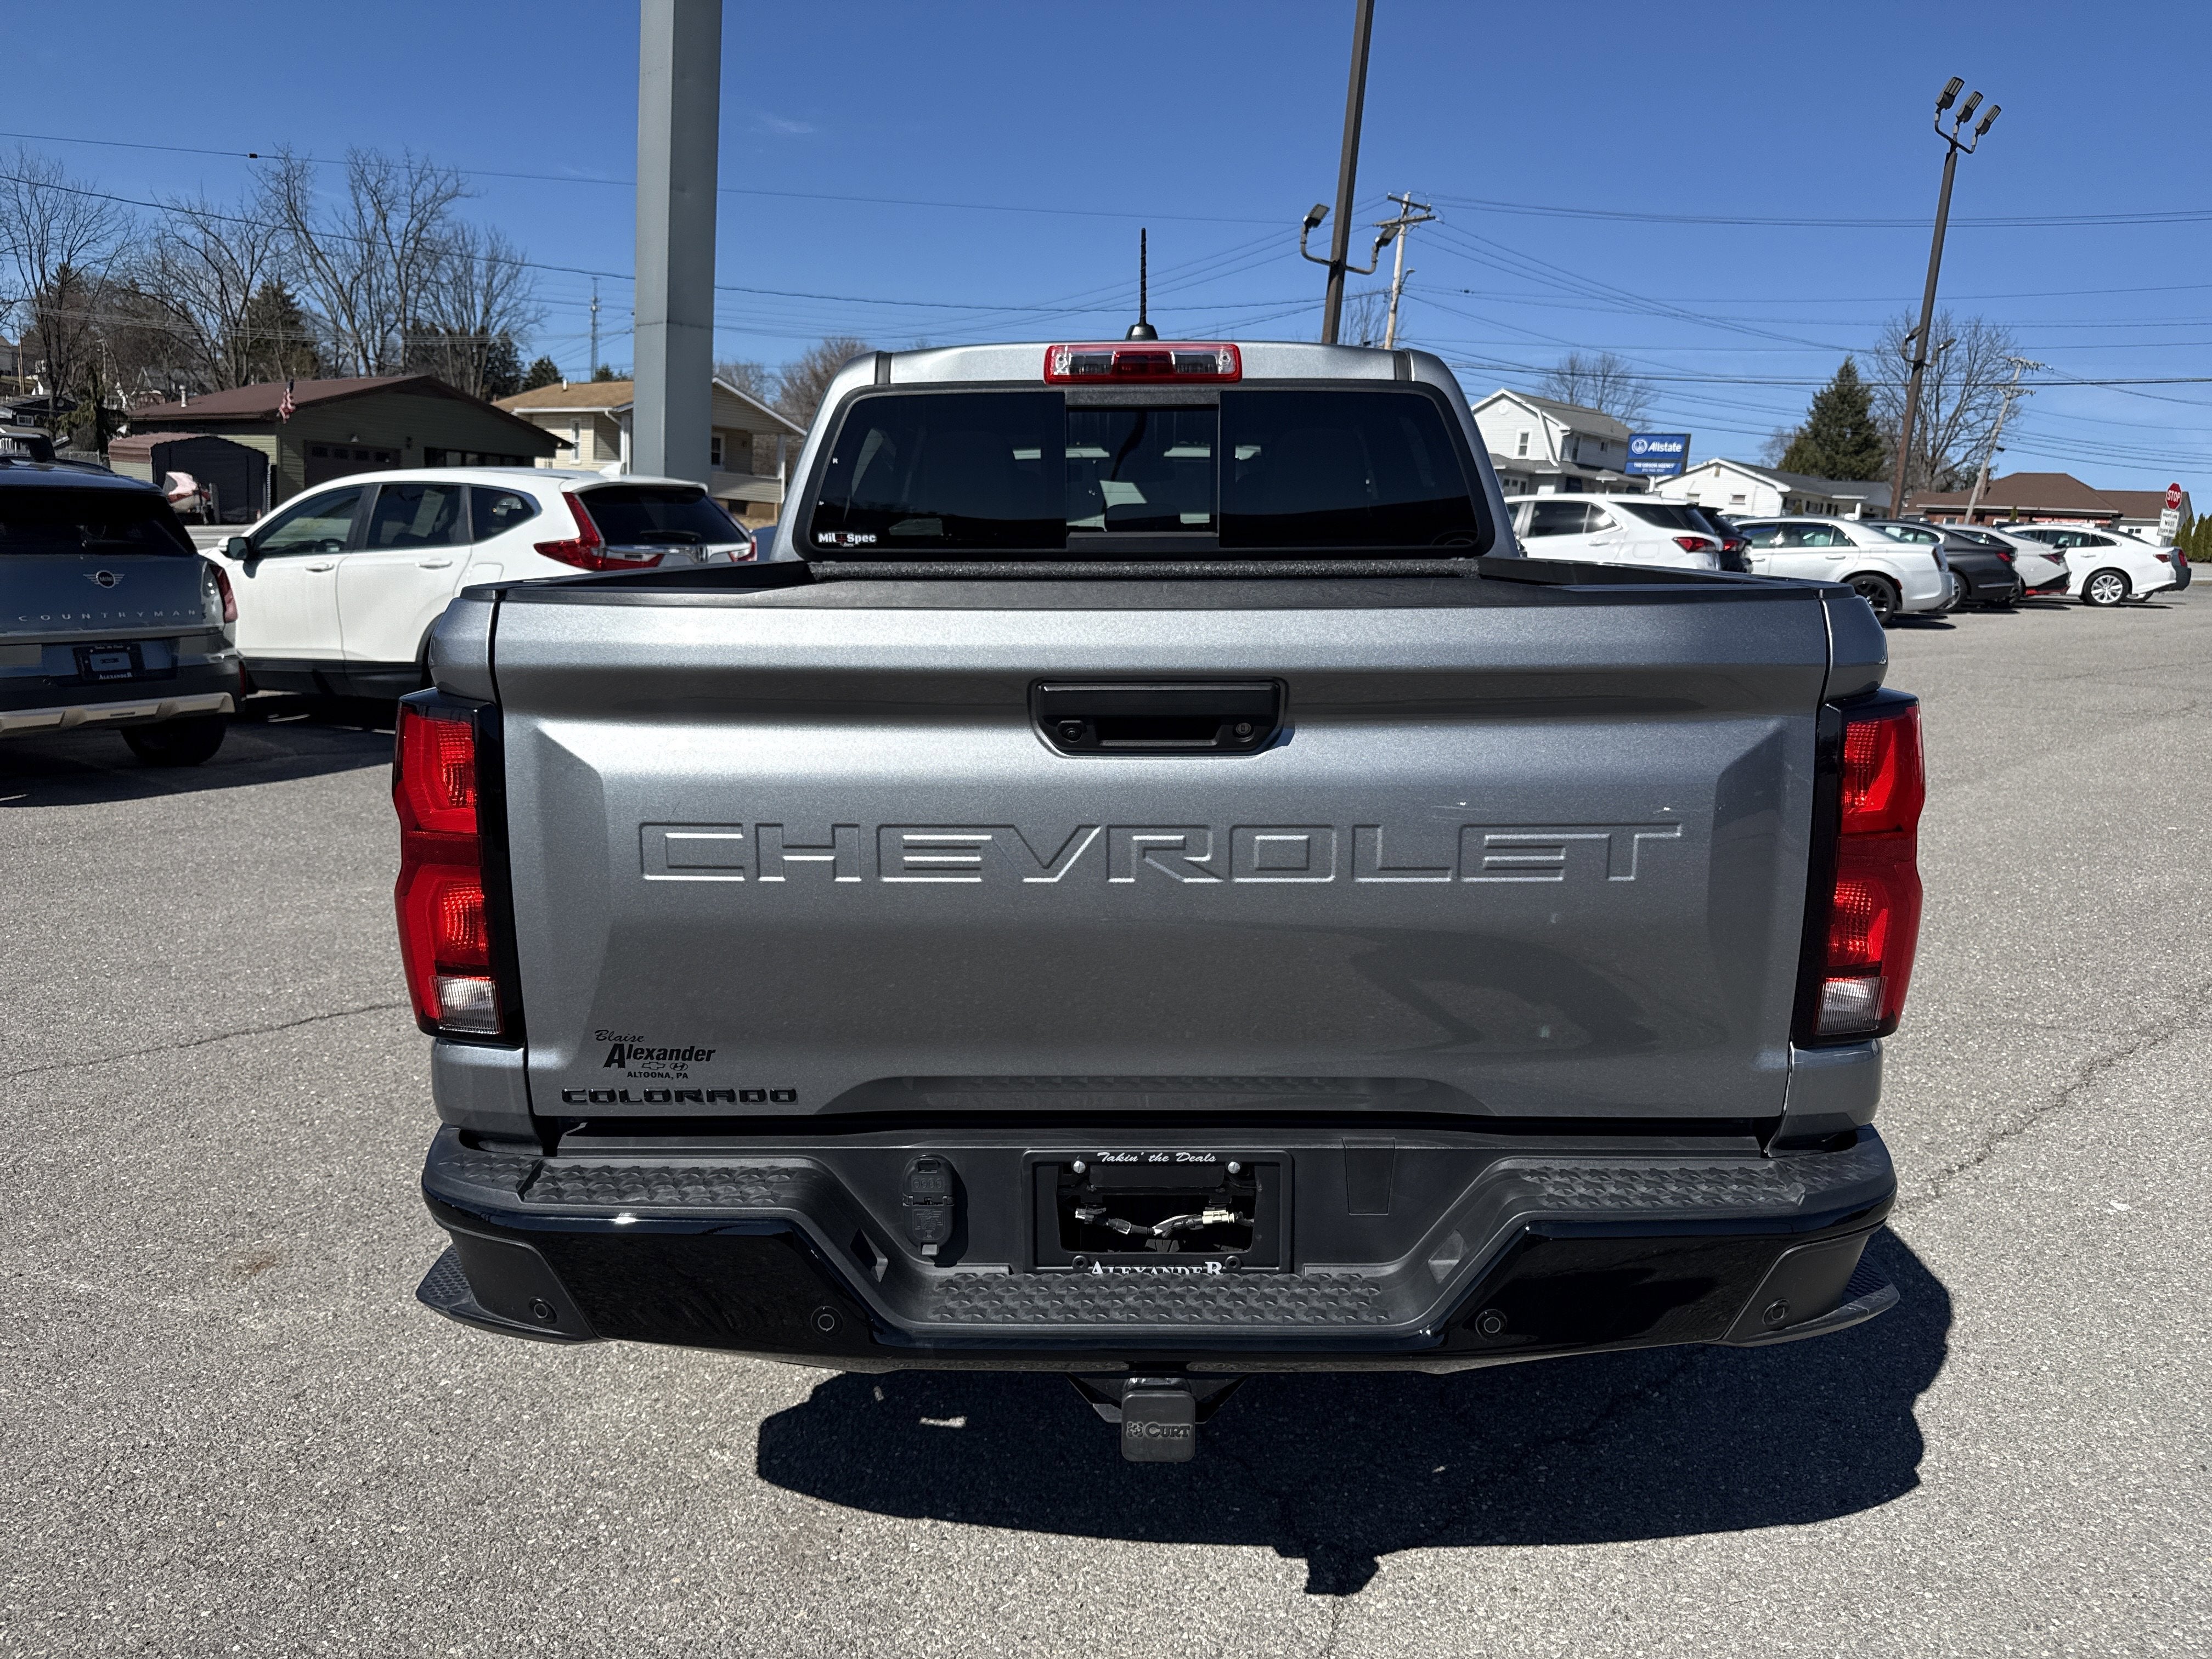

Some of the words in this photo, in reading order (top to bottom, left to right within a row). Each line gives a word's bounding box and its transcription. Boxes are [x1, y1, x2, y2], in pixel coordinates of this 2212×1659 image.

[1647, 441, 1682, 453] Allstate
[2167, 489, 2181, 503] STOP
[818, 532, 837, 543] Mil
[847, 533, 877, 545] Spec
[18, 609, 196, 622] COUNTRYMAN
[640, 822, 1682, 883] CHEVROLET
[594, 1029, 645, 1042] Blaise
[603, 1043, 716, 1069] Alexander
[627, 1071, 674, 1080] ALTOONA,
[561, 1088, 797, 1103] COLORADO
[1097, 1152, 1144, 1162] Takin'
[1148, 1152, 1170, 1162] the
[1175, 1152, 1217, 1162] Deals
